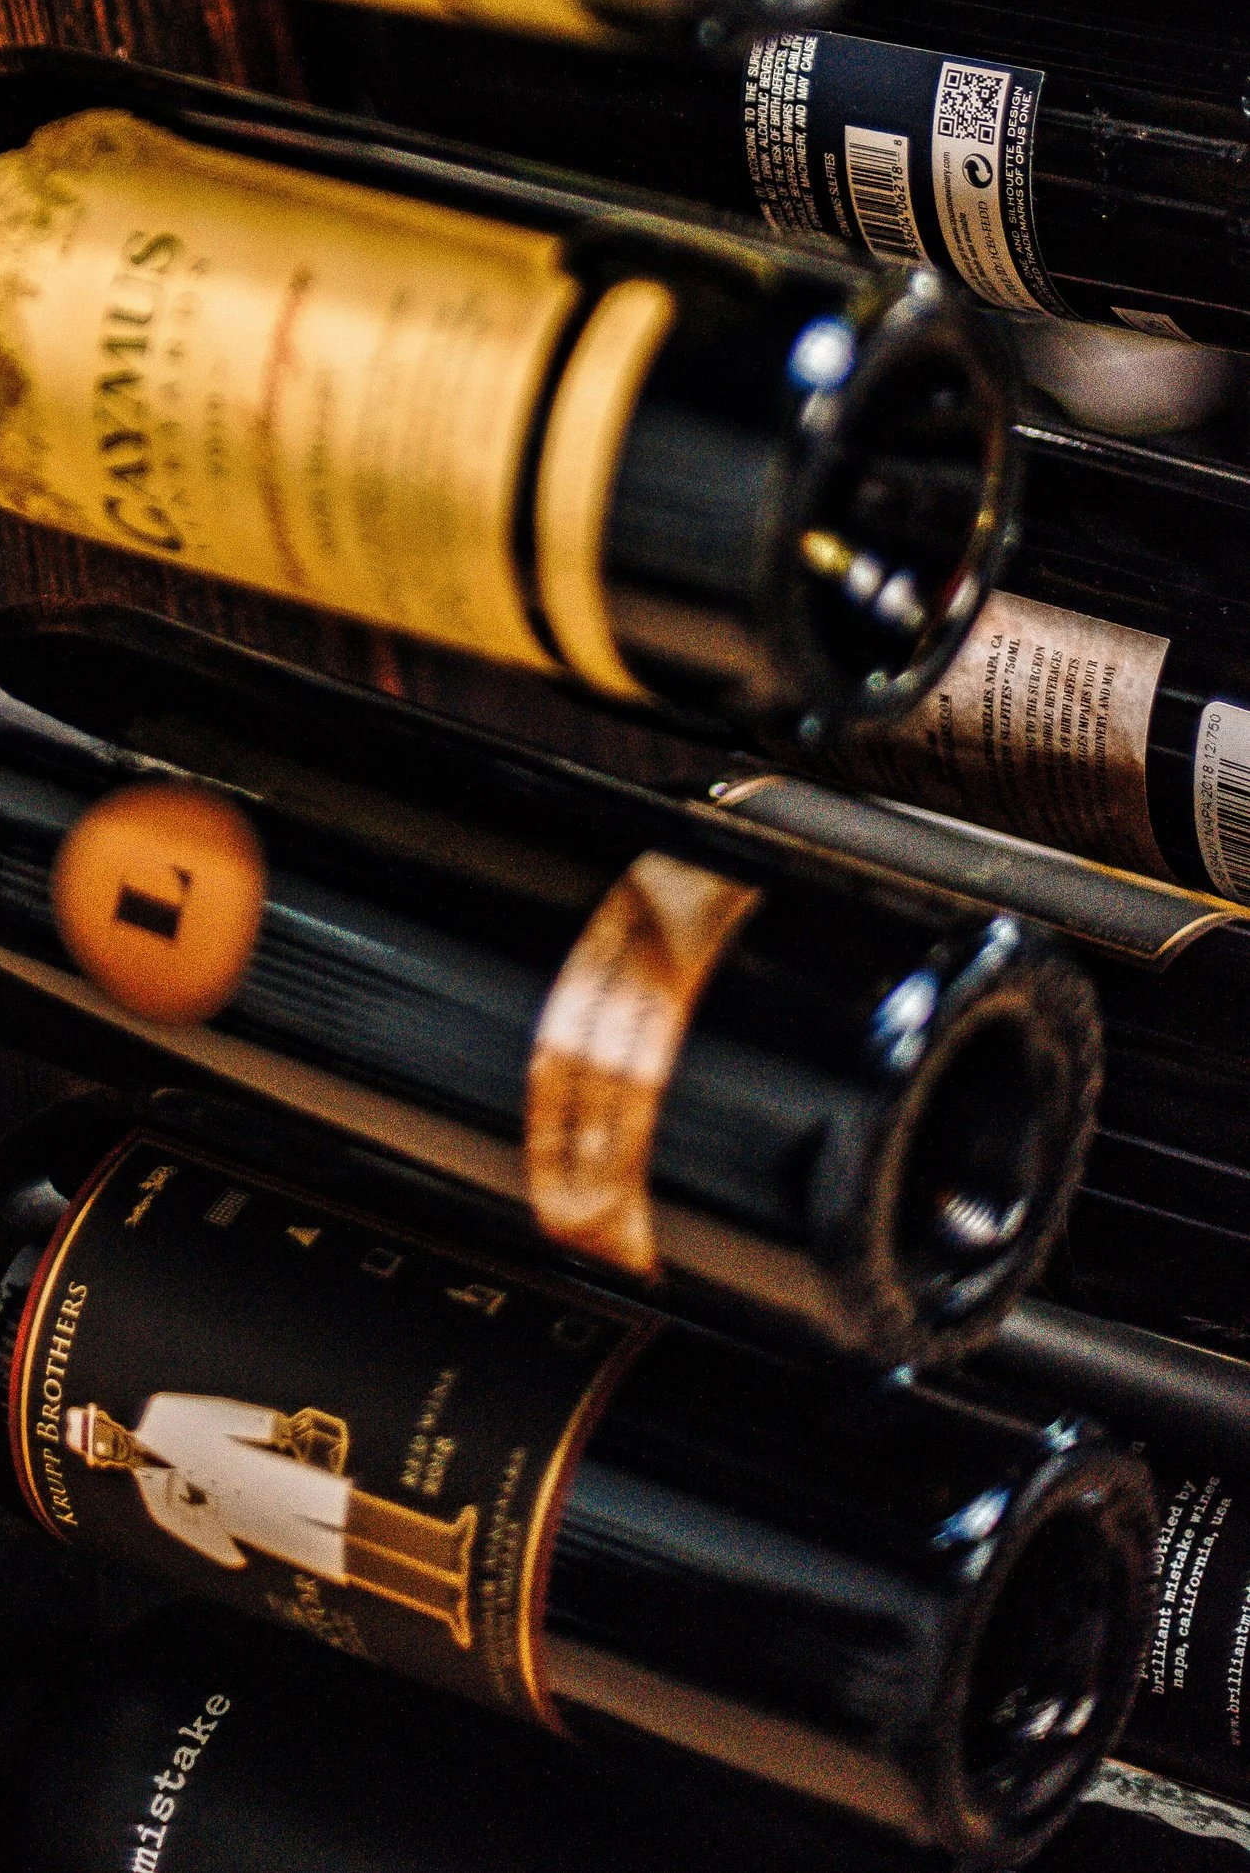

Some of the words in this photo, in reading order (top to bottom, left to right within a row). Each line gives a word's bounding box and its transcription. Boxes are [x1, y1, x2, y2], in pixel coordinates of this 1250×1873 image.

[759, 36, 777, 88] BEVERAG
[787, 33, 803, 70] ABILITY
[800, 35, 817, 71] CAUSE
[772, 47, 788, 94] DEFECTS.
[783, 72, 796, 100] YOUR
[796, 76, 809, 99] MAY
[745, 82, 756, 102] THE
[770, 96, 780, 124] BIRTH
[1018, 89, 1033, 122] ONE.
[745, 107, 754, 121] TO
[757, 91, 768, 146] ALCOHOLIC
[782, 103, 793, 142] IMPAIRS
[794, 104, 807, 126] AND
[1007, 86, 1023, 137] DESIGN
[769, 127, 781, 140] OF
[893, 138, 902, 146] 8
[1015, 126, 1026, 164] OPUS
[746, 127, 760, 181] ACCORDING
[761, 152, 772, 177] DRINK
[770, 143, 782, 163] RISK
[784, 146, 800, 195] BEVERAGES
[796, 131, 810, 186] MACHINERY,
[775, 168, 785, 182] THE
[824, 152, 837, 194] SULFITES
[892, 165, 906, 209] 06218
[1005, 144, 1018, 222] SILHOUETTE
[1015, 167, 1024, 185] OF
[1012, 230, 1024, 252] AND
[1020, 189, 1036, 264] TRADEMARKS
[1022, 257, 1034, 276] ONE
[990, 633, 1002, 648] CA
[1003, 637, 1020, 674] 750ML
[985, 651, 1000, 683] NAPA,
[1025, 696, 1037, 717] THE
[1031, 645, 1046, 694] SURGEON
[1045, 649, 1062, 707] BEVERAGES
[1063, 655, 1080, 700] DEFECTS.
[1083, 659, 1098, 687] YOUR
[1102, 664, 1115, 686] MAY
[982, 685, 995, 734] CELLARS,
[1076, 690, 1092, 732] IMPAIRS
[1098, 688, 1111, 709] AND
[1059, 703, 1072, 733] BIRTH
[1204, 713, 1221, 759] 12/750
[1058, 733, 1070, 747] OF
[1202, 764, 1213, 797] 2018
[1202, 801, 1213, 833] NAPA
[36, 1280, 89, 1439] BROTHERS
[43, 1449, 77, 1523] KRUPP
[1175, 1478, 1198, 1499] by
[1210, 1496, 1232, 1526] usa
[1150, 1605, 1173, 1693] brilliant
[1162, 1525, 1196, 1602] mistake
[1187, 1474, 1221, 1523] wines
[1175, 1528, 1219, 1636] california,
[1171, 1641, 1189, 1687] napa,
[132, 1694, 231, 1873] mistake
